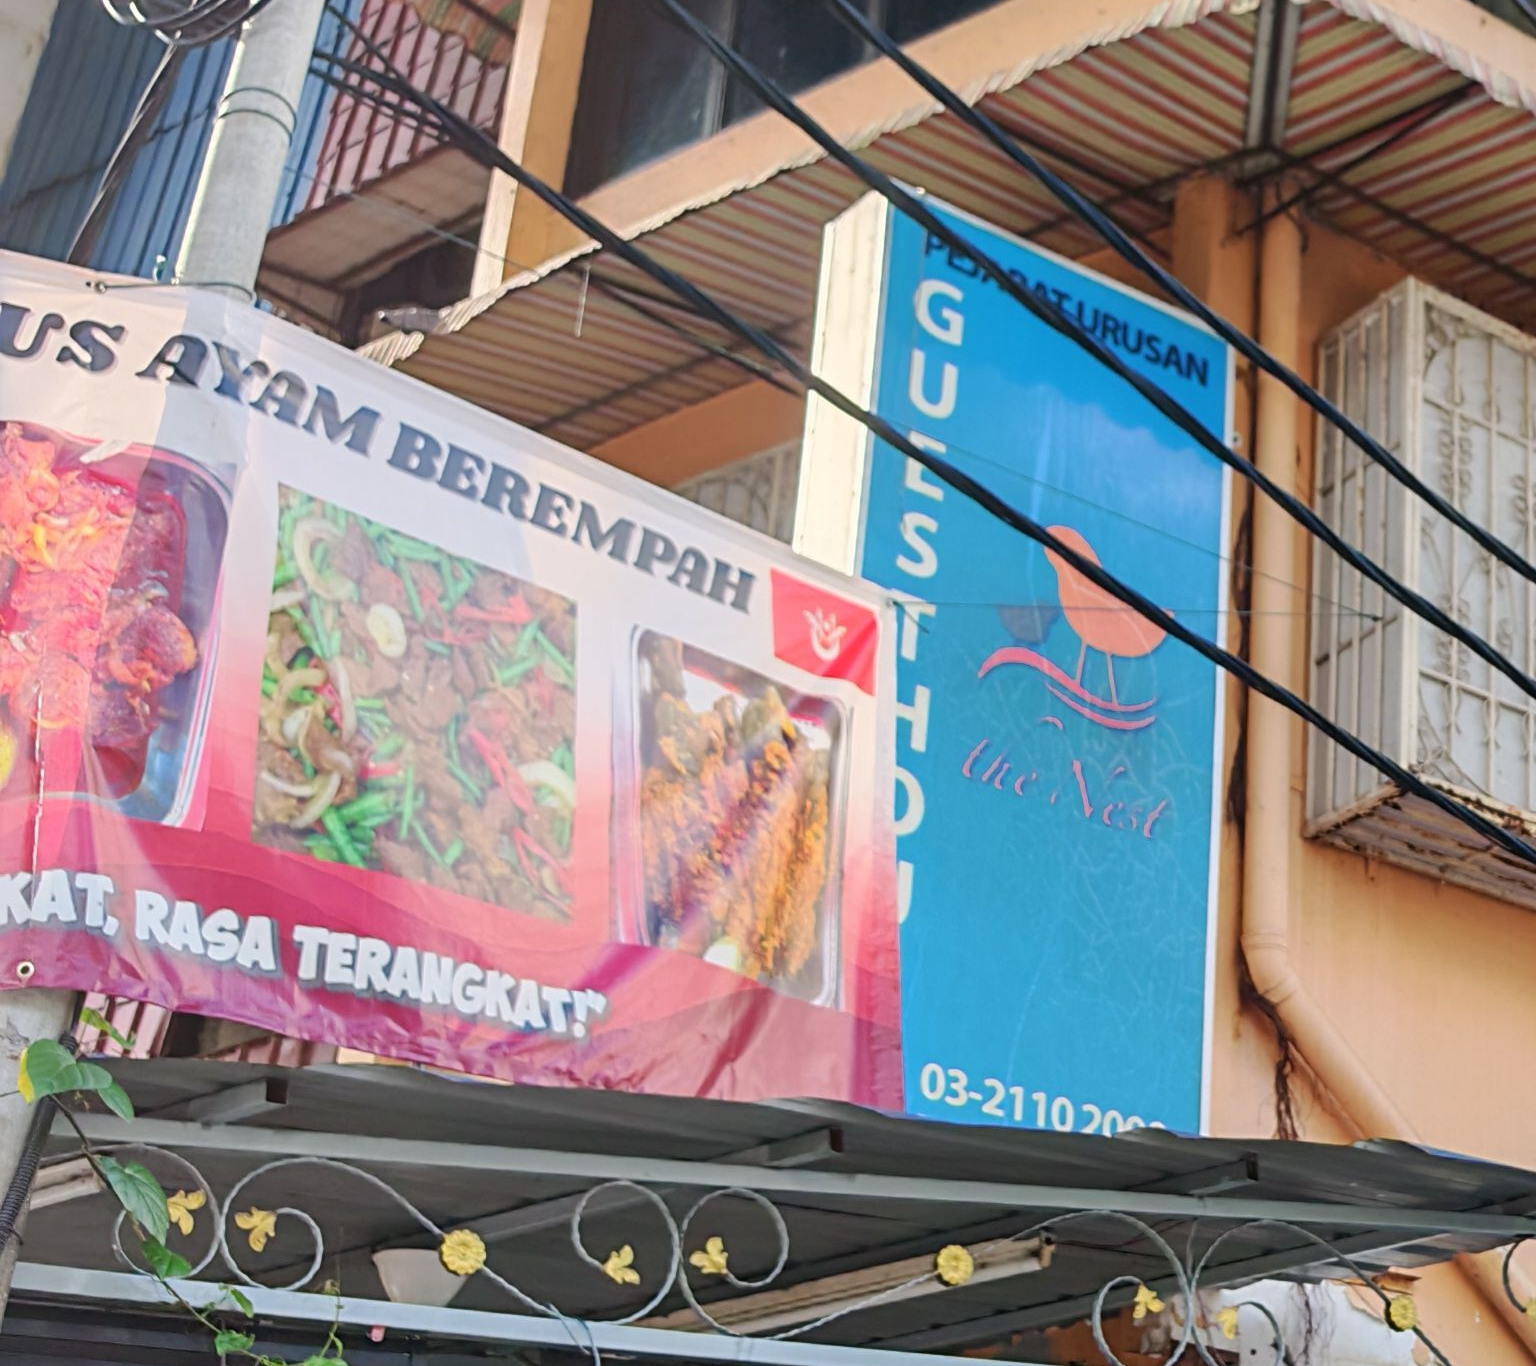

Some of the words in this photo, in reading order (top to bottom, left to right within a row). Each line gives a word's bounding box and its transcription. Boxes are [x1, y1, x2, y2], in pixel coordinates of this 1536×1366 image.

[1076, 298, 1209, 387] URUSAN
[135, 334, 380, 457] AYAM
[387, 428, 757, 616] BEREMPAH
[135, 889, 277, 971] RASA
